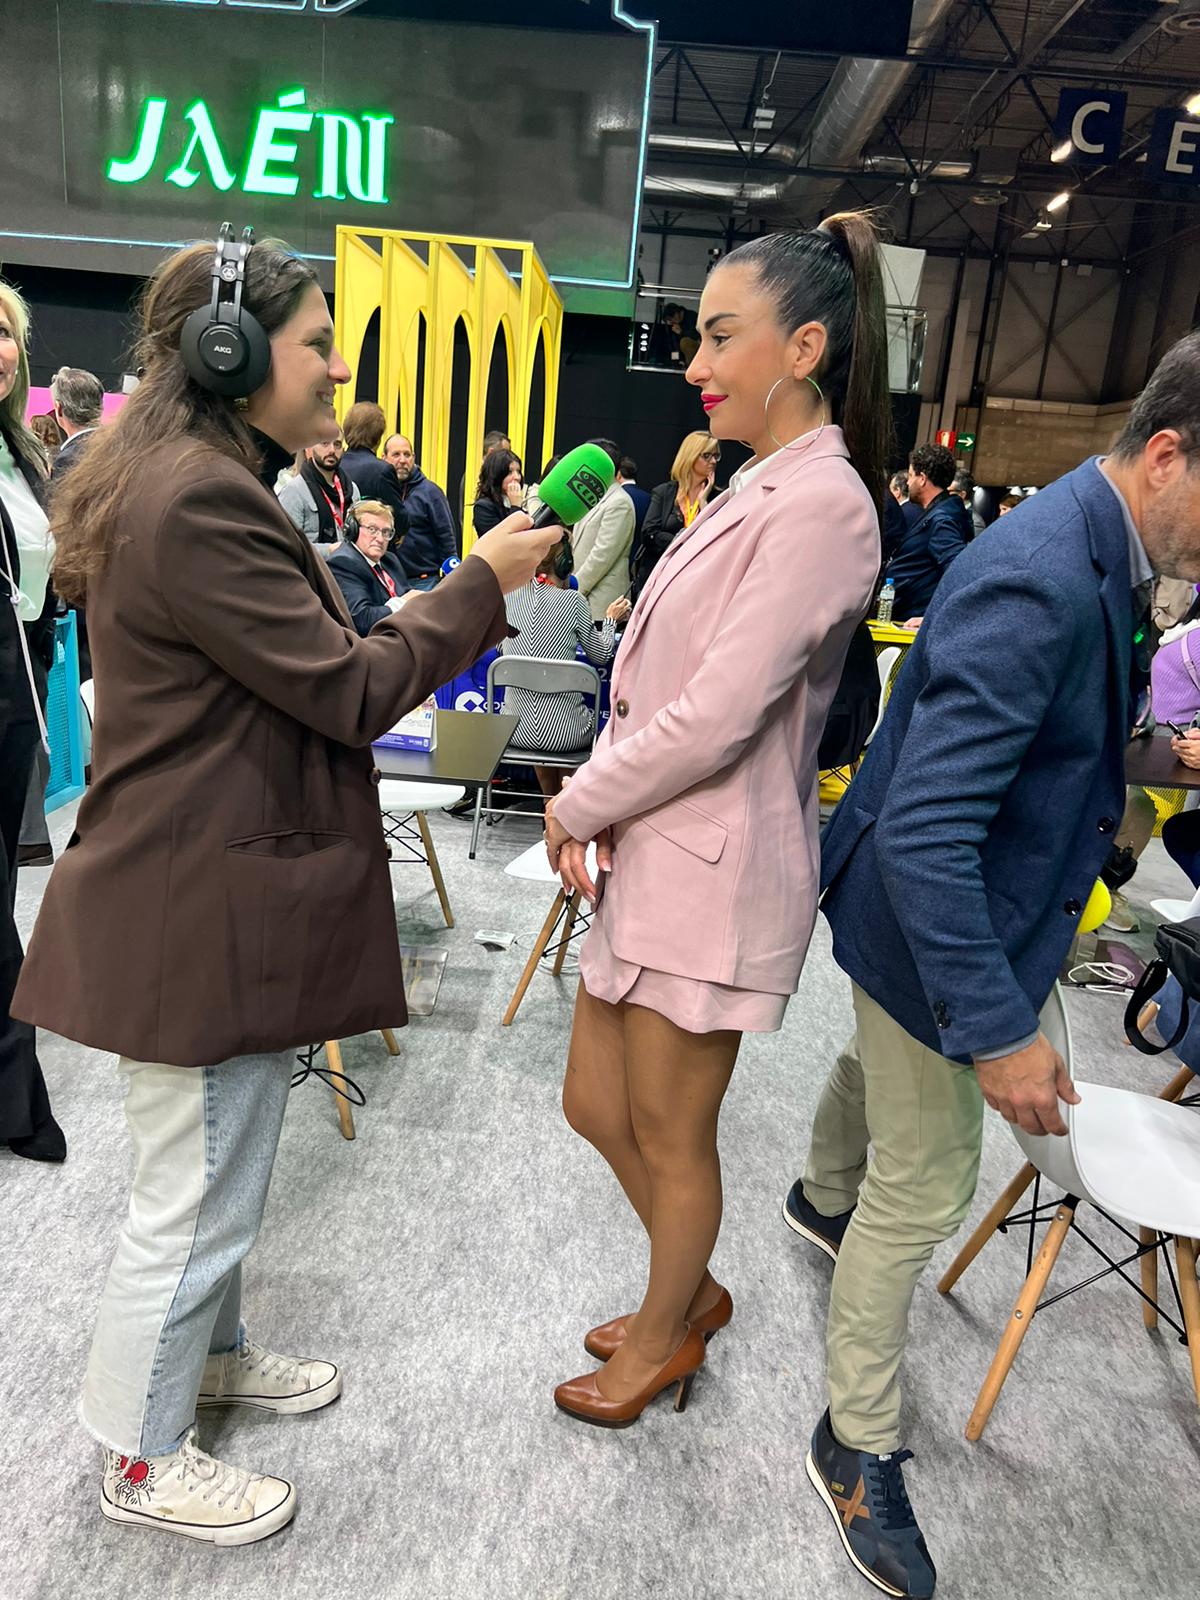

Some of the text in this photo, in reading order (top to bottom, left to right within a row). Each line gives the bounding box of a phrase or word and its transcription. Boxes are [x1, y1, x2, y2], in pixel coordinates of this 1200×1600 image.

[107, 88, 394, 203] JAÉN
[1071, 101, 1111, 154] C
[1165, 121, 1200, 174] E
[213, 345, 232, 354] AKG
